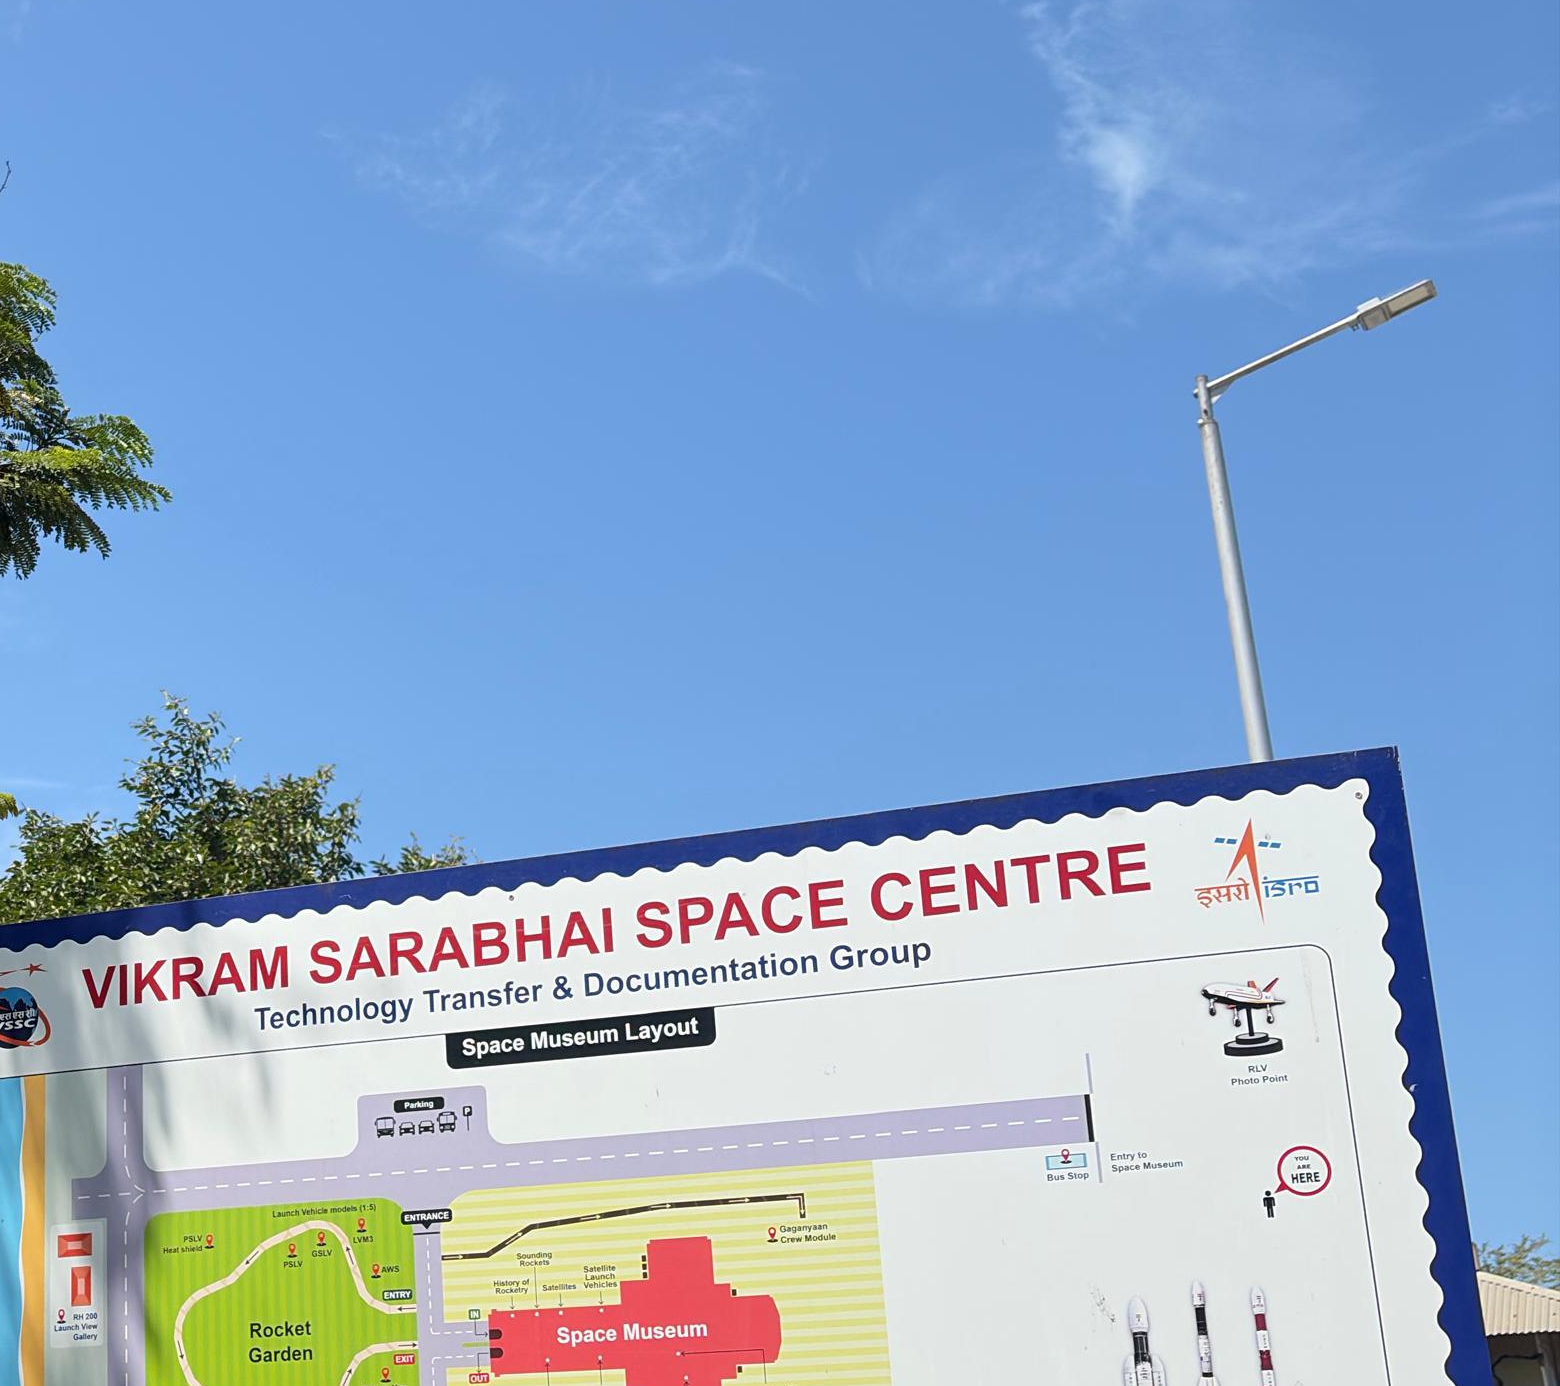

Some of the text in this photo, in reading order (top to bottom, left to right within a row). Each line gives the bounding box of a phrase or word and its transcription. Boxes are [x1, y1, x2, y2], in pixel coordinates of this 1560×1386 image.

[1194, 877, 1250, 909] इसरो
[83, 842, 1152, 1010] VIKRAM SARABHAI SPACE CENTRE
[254, 938, 932, 1034] Technology Transfer & Documentation Group
[462, 1015, 700, 1060] Space Museum Layout
[1247, 1064, 1268, 1073] RLV
[1231, 1074, 1289, 1086] Photo Point
[404, 1100, 434, 1110] Parking
[1110, 1151, 1148, 1163] Entry to
[1112, 1159, 1184, 1174] Space Museum
[1047, 1171, 1090, 1182] Bus Stop
[1291, 1171, 1321, 1185] HERE
[272, 1203, 377, 1219] Launch Vehicle models (1:5)
[404, 1210, 450, 1222] ENTRANCE
[780, 1223, 828, 1234] Gaganyaan
[183, 1235, 203, 1243] PSLV
[353, 1235, 374, 1244] LVM3
[780, 1233, 837, 1245] Crew Module
[163, 1244, 203, 1255] Heat shield
[311, 1249, 333, 1258] GSLV
[516, 1251, 553, 1261] Sounding
[283, 1260, 303, 1269] PSLV
[519, 1258, 550, 1268] Rockets
[381, 1265, 400, 1273] AWS
[583, 1264, 616, 1274] Satellite
[585, 1272, 616, 1281] Launch
[493, 1278, 530, 1289] History of
[542, 1283, 577, 1292] Satellites
[583, 1280, 618, 1289] Vehicles
[383, 1290, 411, 1300] ENTRY
[495, 1286, 529, 1296] Rocketry
[73, 1312, 98, 1321] RH 200
[470, 1310, 480, 1319] IN
[54, 1322, 98, 1332] Launch View
[249, 1320, 312, 1339] Rocket
[73, 1333, 98, 1341] Gallery
[556, 1322, 708, 1347] Space Museum
[249, 1345, 313, 1363] Garden
[395, 1354, 415, 1364] EXIT
[471, 1373, 489, 1383] OUT
